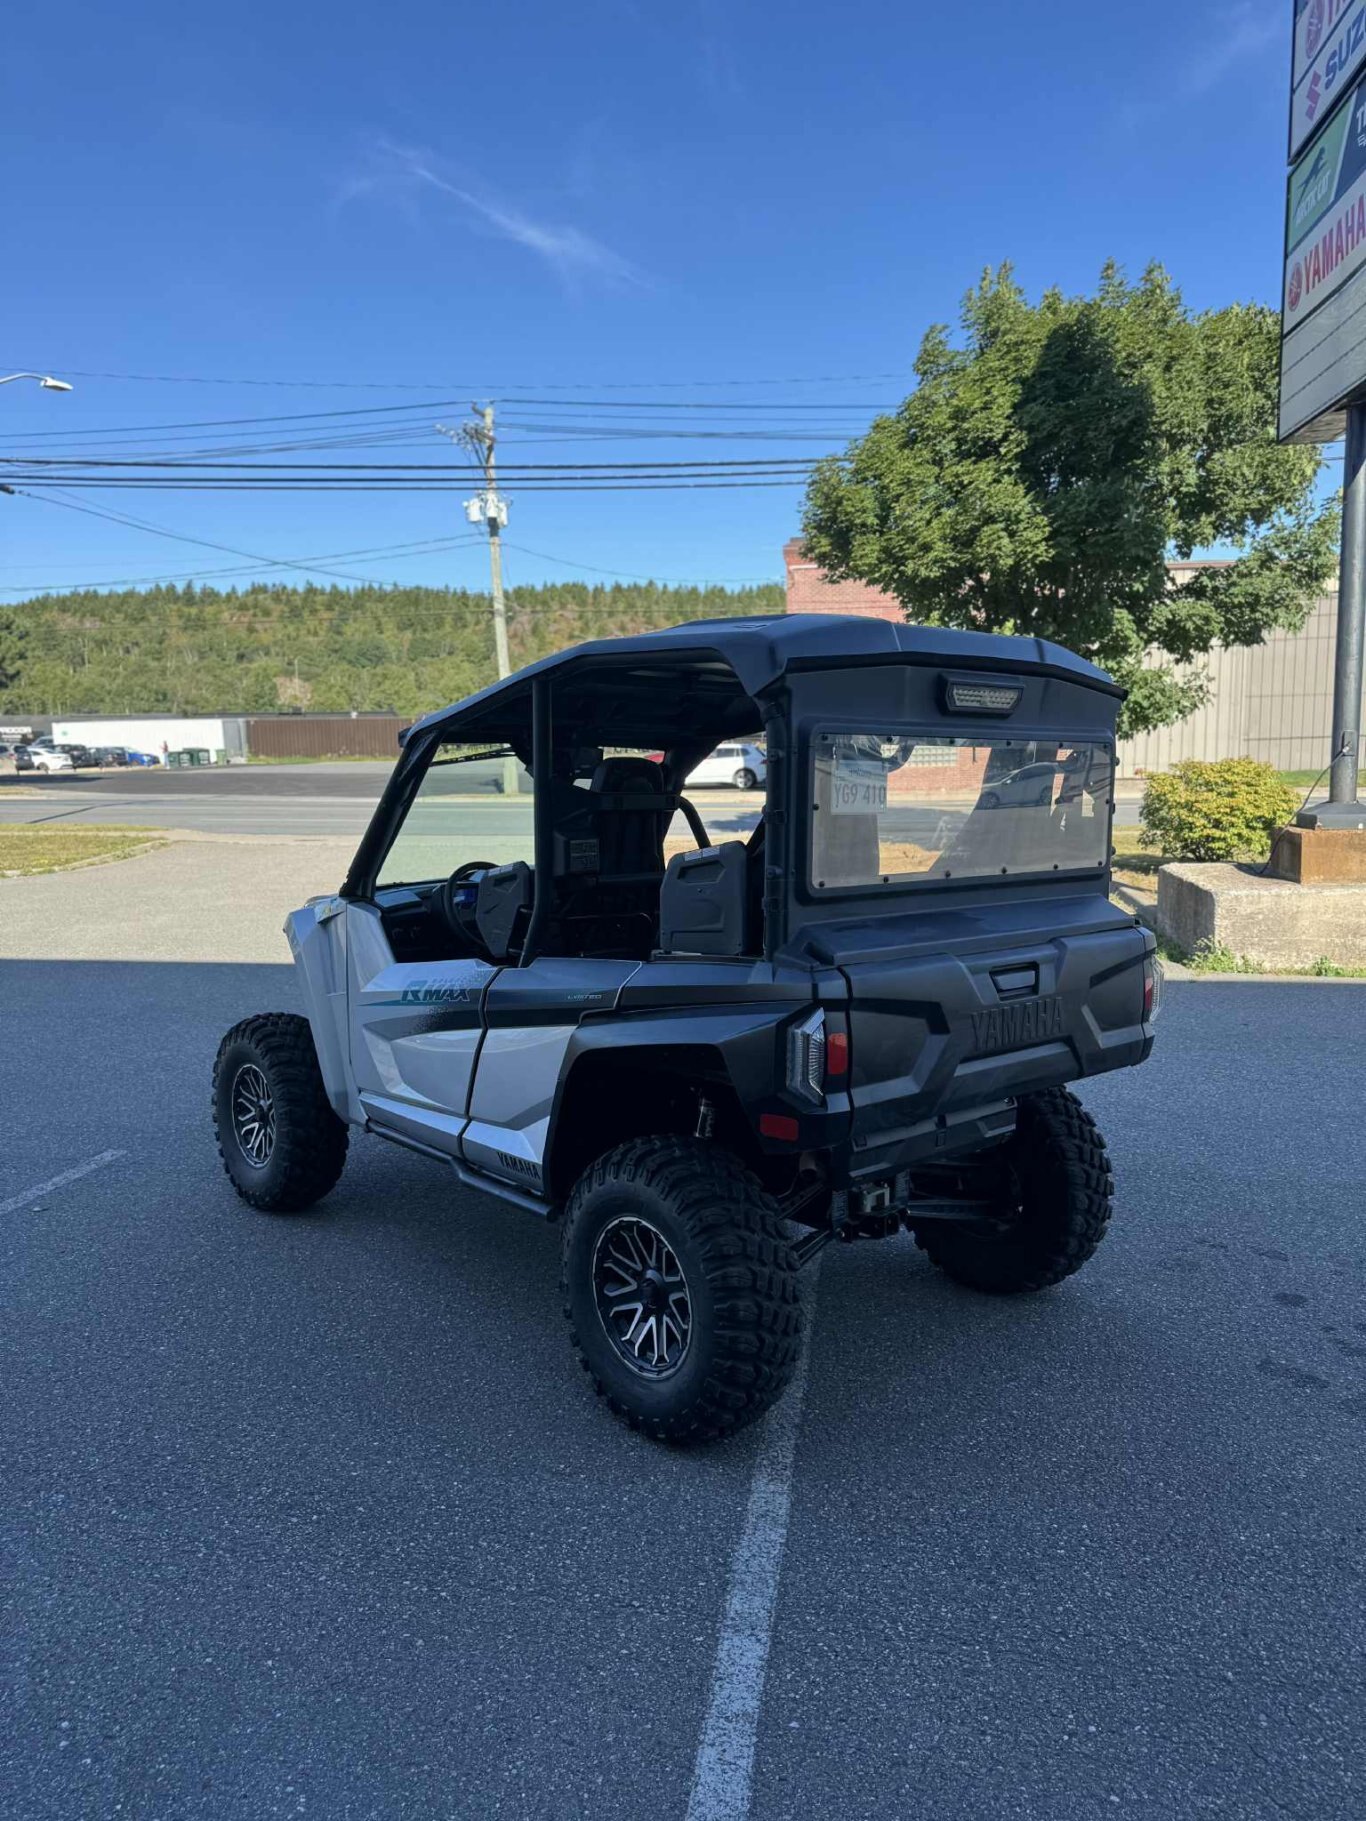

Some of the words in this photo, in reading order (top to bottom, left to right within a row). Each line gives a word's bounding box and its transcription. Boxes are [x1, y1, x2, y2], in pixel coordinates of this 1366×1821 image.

[1325, 5, 1366, 90] SUZ
[1304, 193, 1366, 295] YAMAHA
[970, 997, 1064, 1050] YAMAHA
[497, 1152, 540, 1180] YAMAHA
